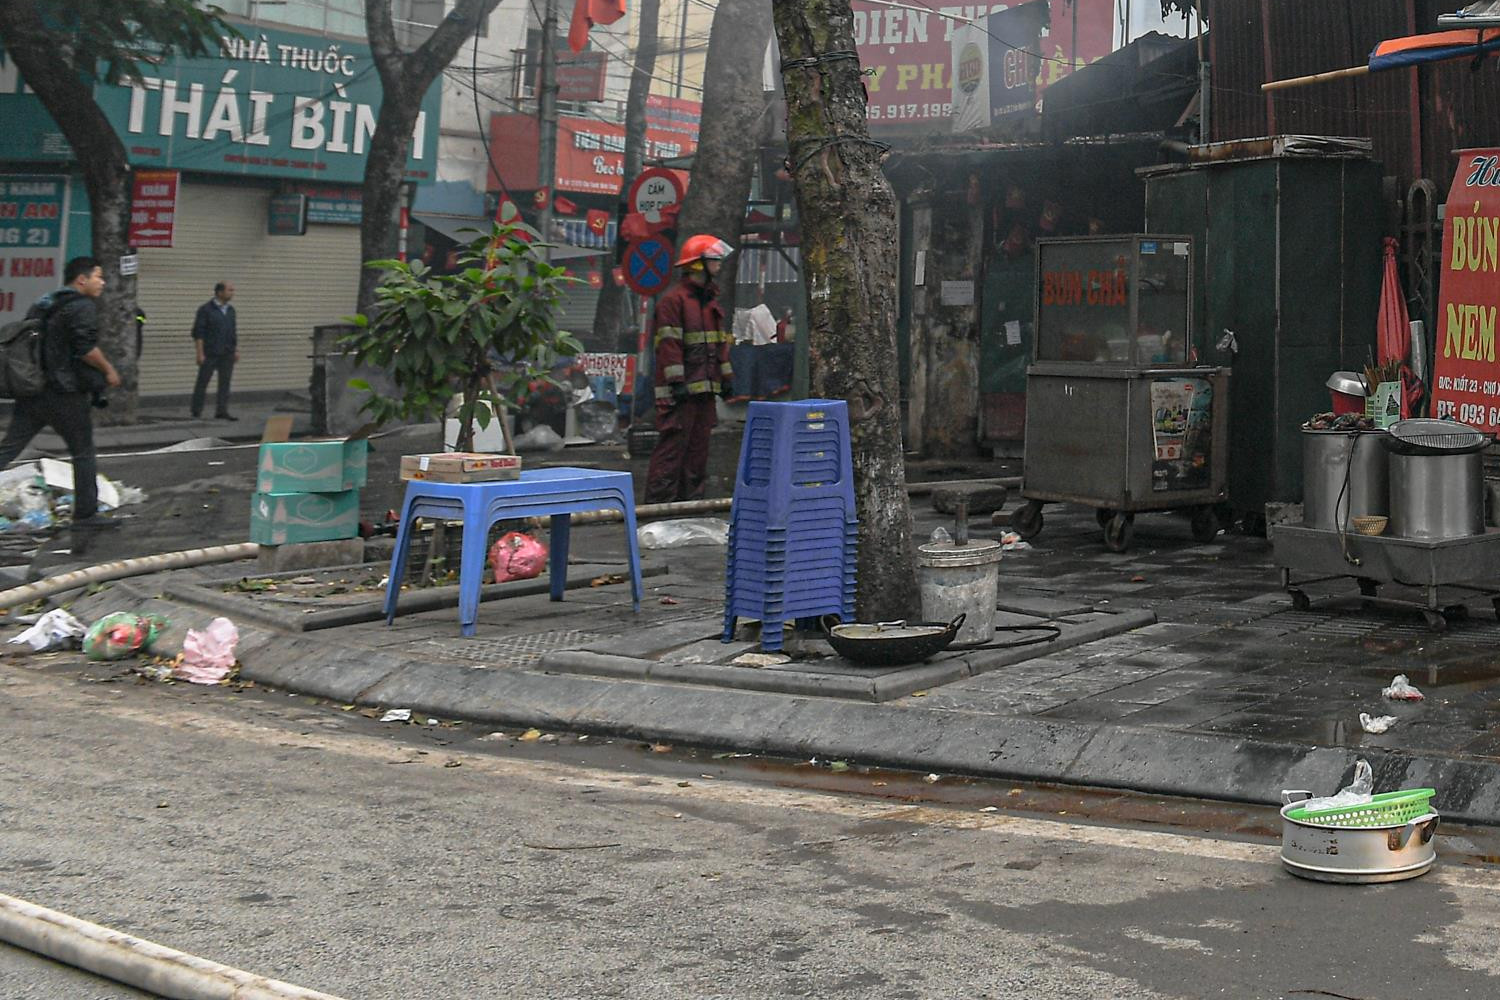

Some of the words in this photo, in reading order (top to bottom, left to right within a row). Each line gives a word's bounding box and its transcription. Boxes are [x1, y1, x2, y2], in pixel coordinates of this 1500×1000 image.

[220, 34, 271, 64] NHÀ
[277, 44, 356, 77] THUỐC
[118, 70, 274, 146] THÁI
[1451, 200, 1499, 273] BÚN
[1444, 303, 1497, 363] NEM
[1460, 403, 1485, 425] 093
